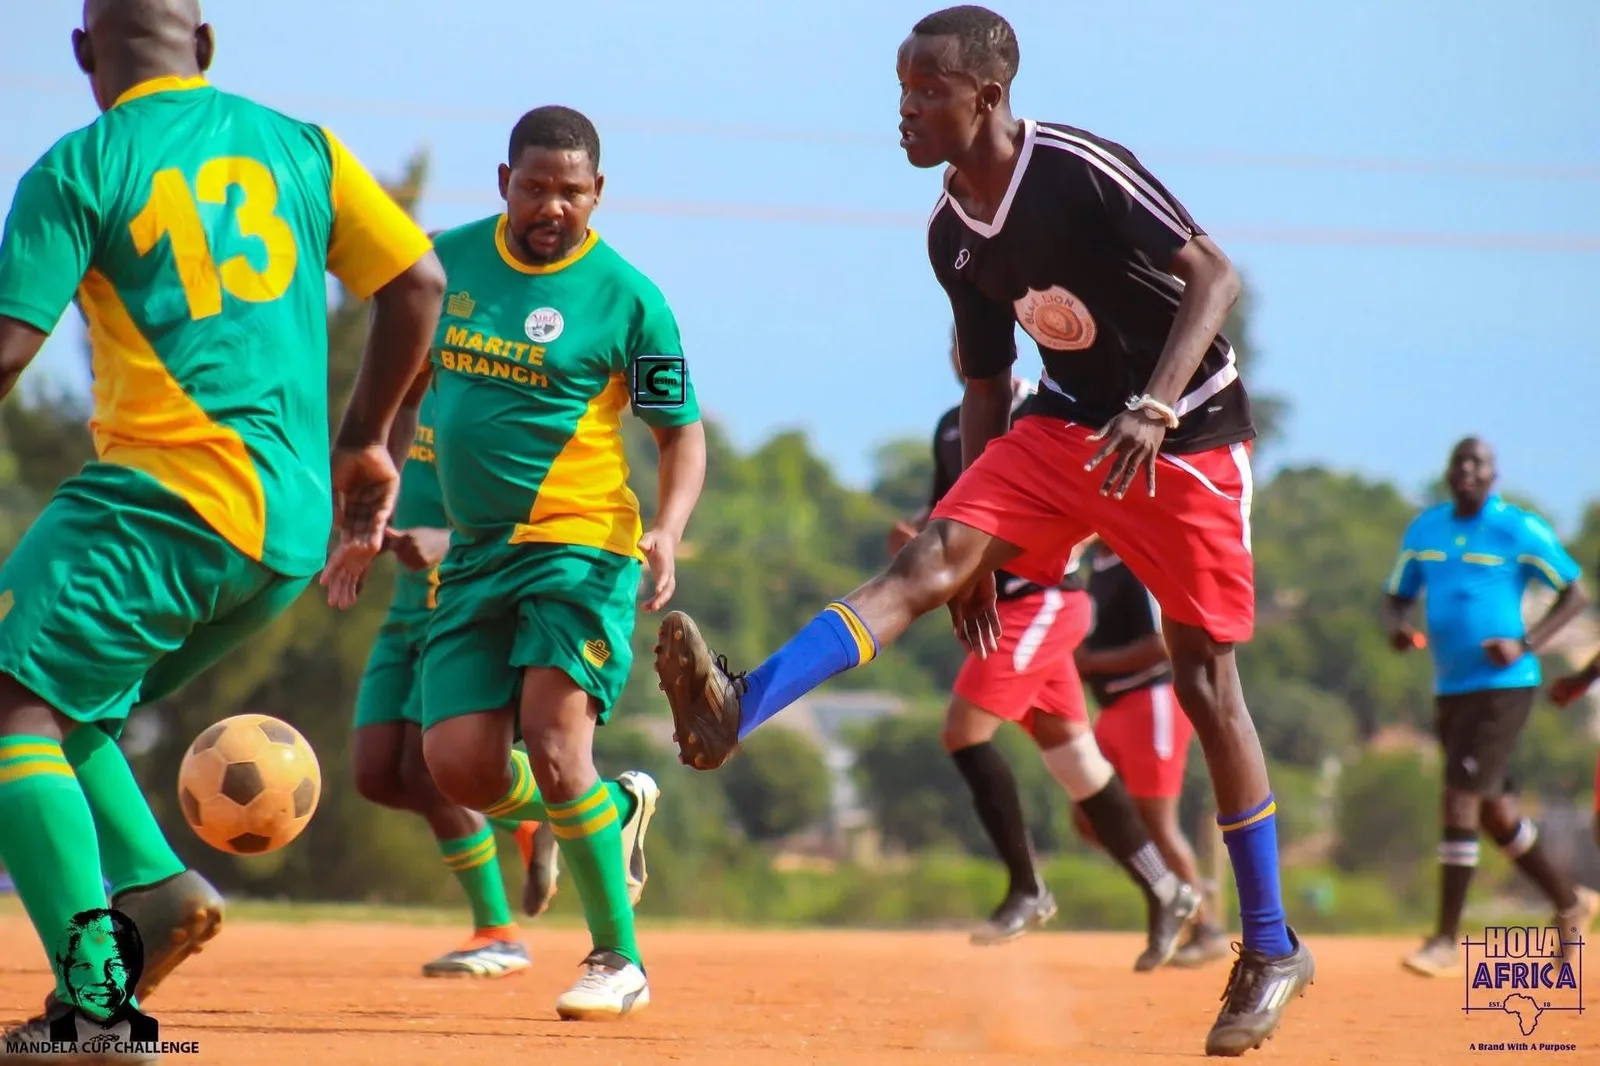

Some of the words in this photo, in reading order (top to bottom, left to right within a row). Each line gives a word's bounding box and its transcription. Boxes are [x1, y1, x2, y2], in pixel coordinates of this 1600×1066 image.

[128, 155, 298, 321] 13
[1041, 293, 1074, 308] LION
[445, 325, 547, 366] MARITE
[441, 350, 548, 388] BRANCH
